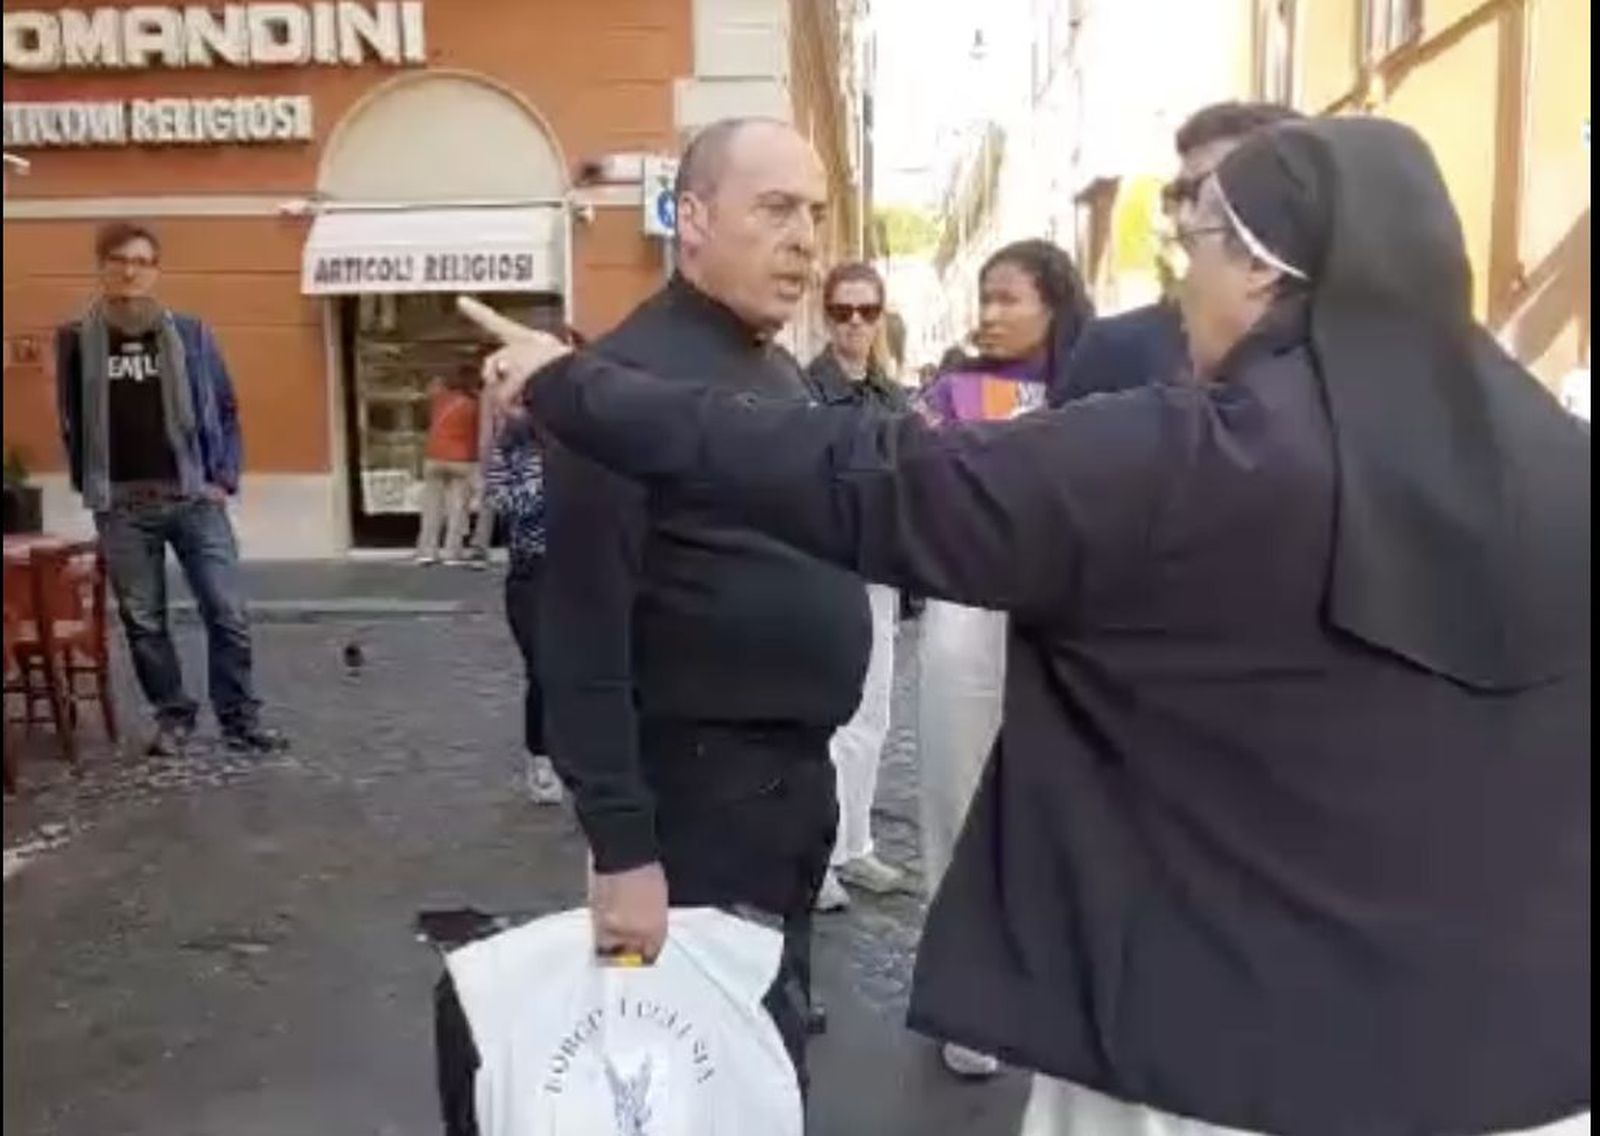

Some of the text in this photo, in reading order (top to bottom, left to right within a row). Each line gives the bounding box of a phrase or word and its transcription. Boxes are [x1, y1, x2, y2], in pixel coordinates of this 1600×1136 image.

[131, 96, 311, 142] RELIGIOSI
[314, 252, 533, 283] ARTICOLI RELIGIOSI
